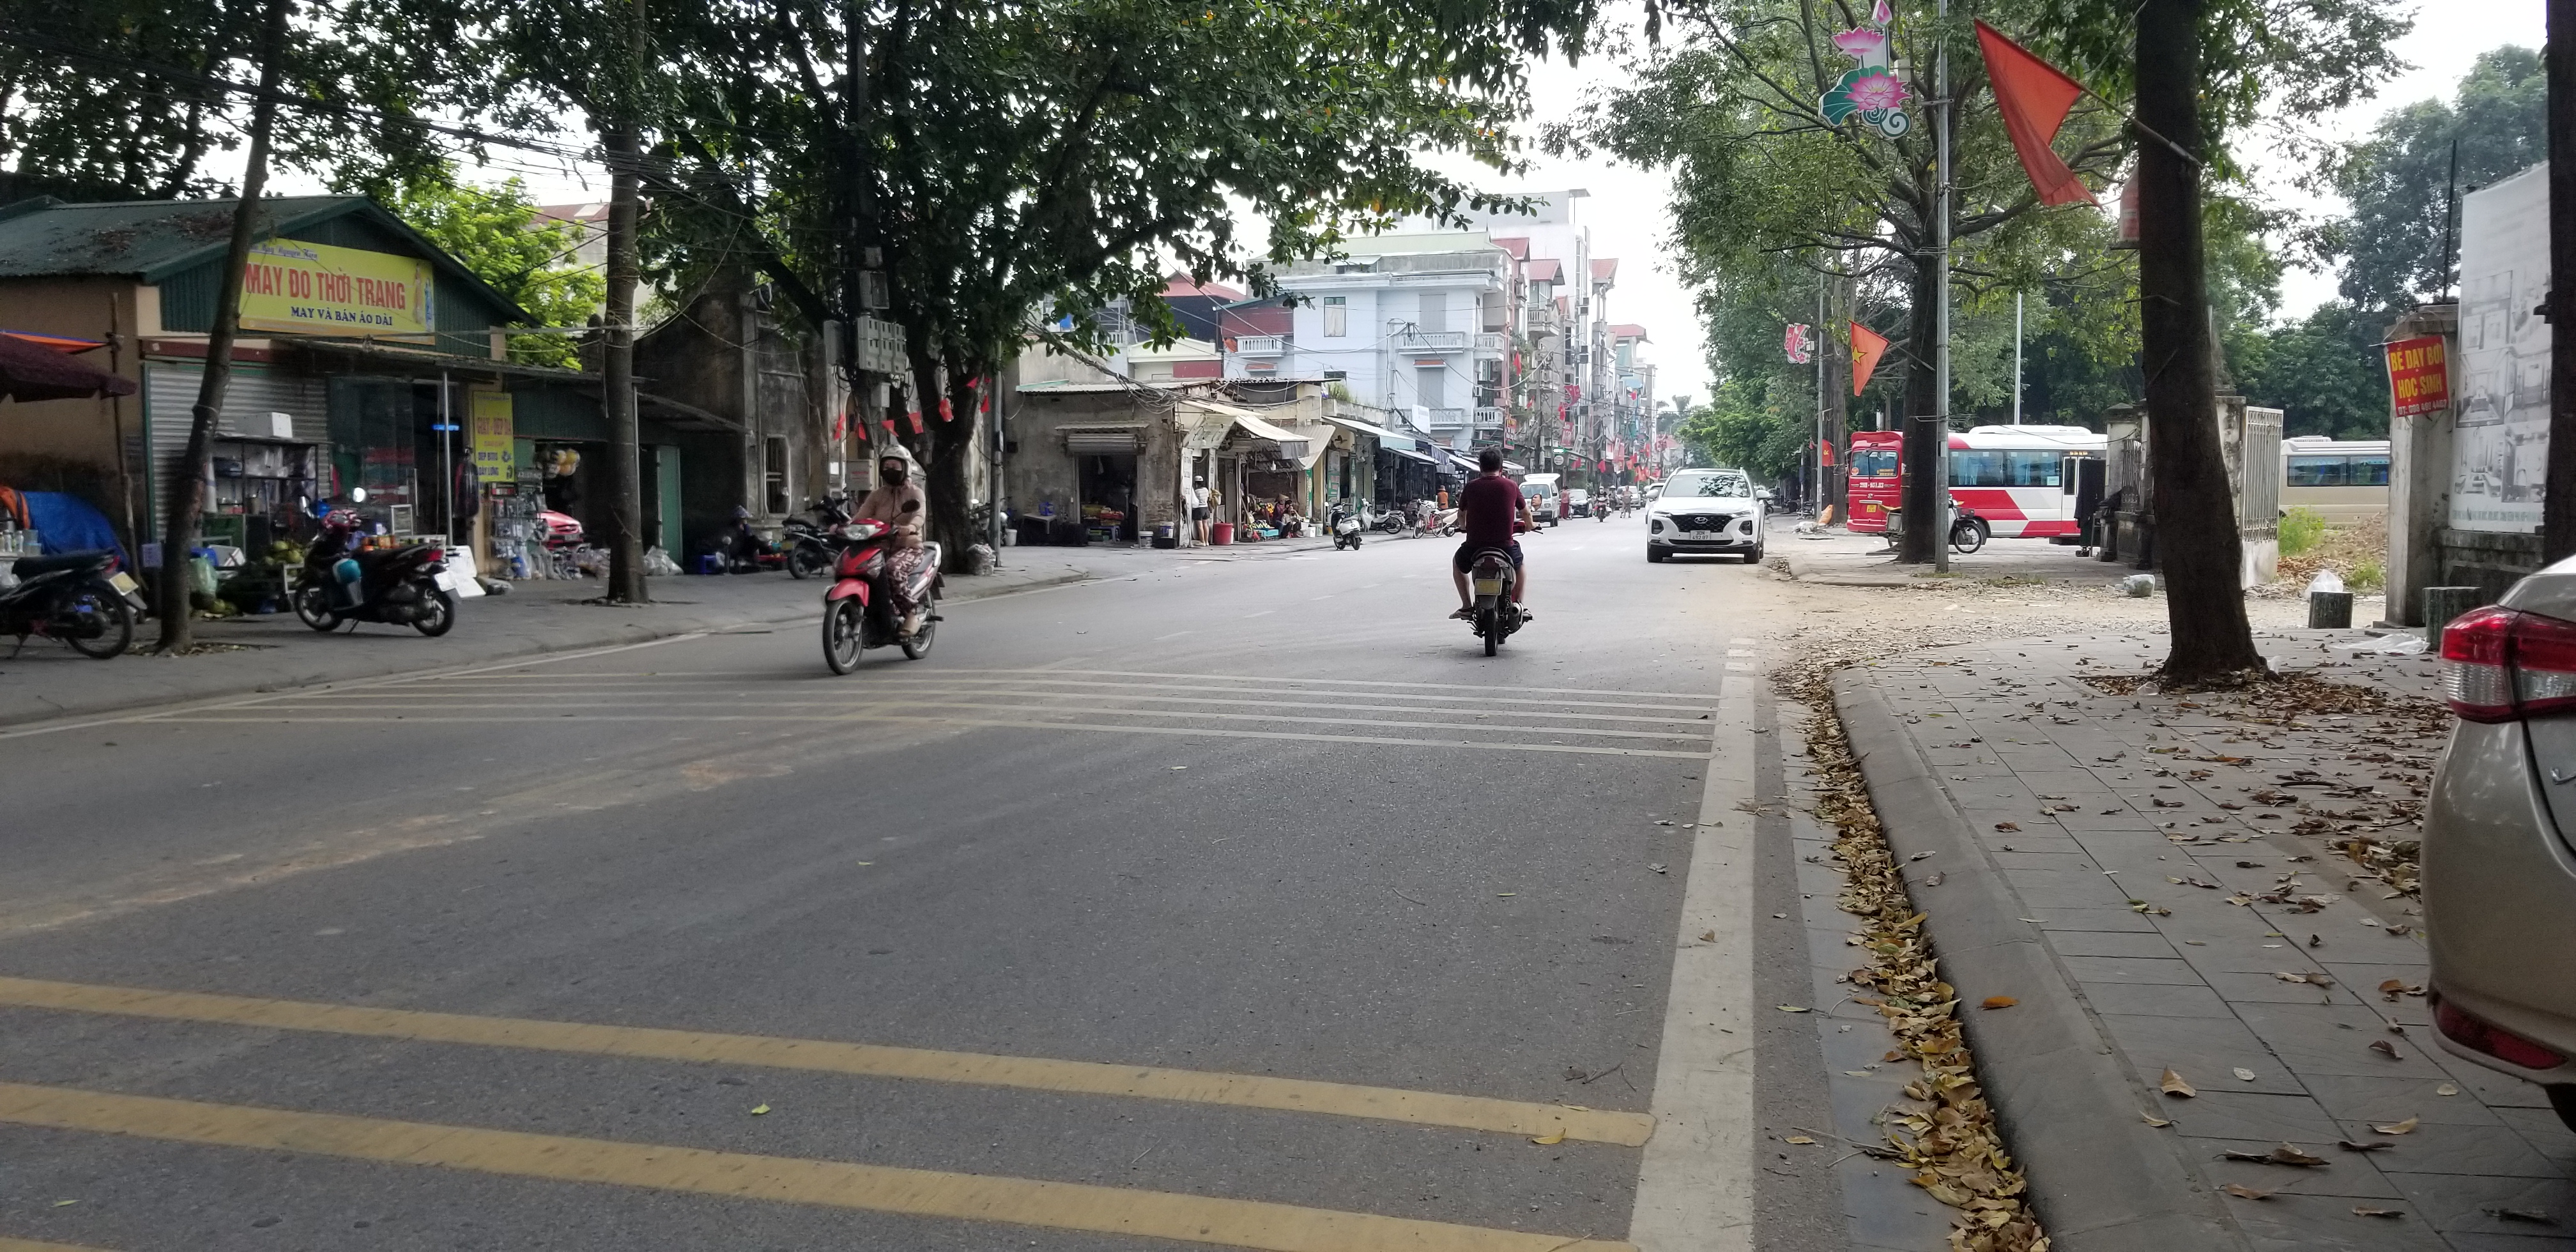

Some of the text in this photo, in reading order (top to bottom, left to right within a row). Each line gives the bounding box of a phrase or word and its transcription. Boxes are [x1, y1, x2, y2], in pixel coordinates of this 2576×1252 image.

[245, 263, 406, 310] MAY ĐO THỜI TRANG
[291, 306, 393, 325] MAY VÀ BÁN ÁO DÀI
[2405, 347, 2425, 372] DẠY
[2397, 373, 2443, 402] HỌC SINH
